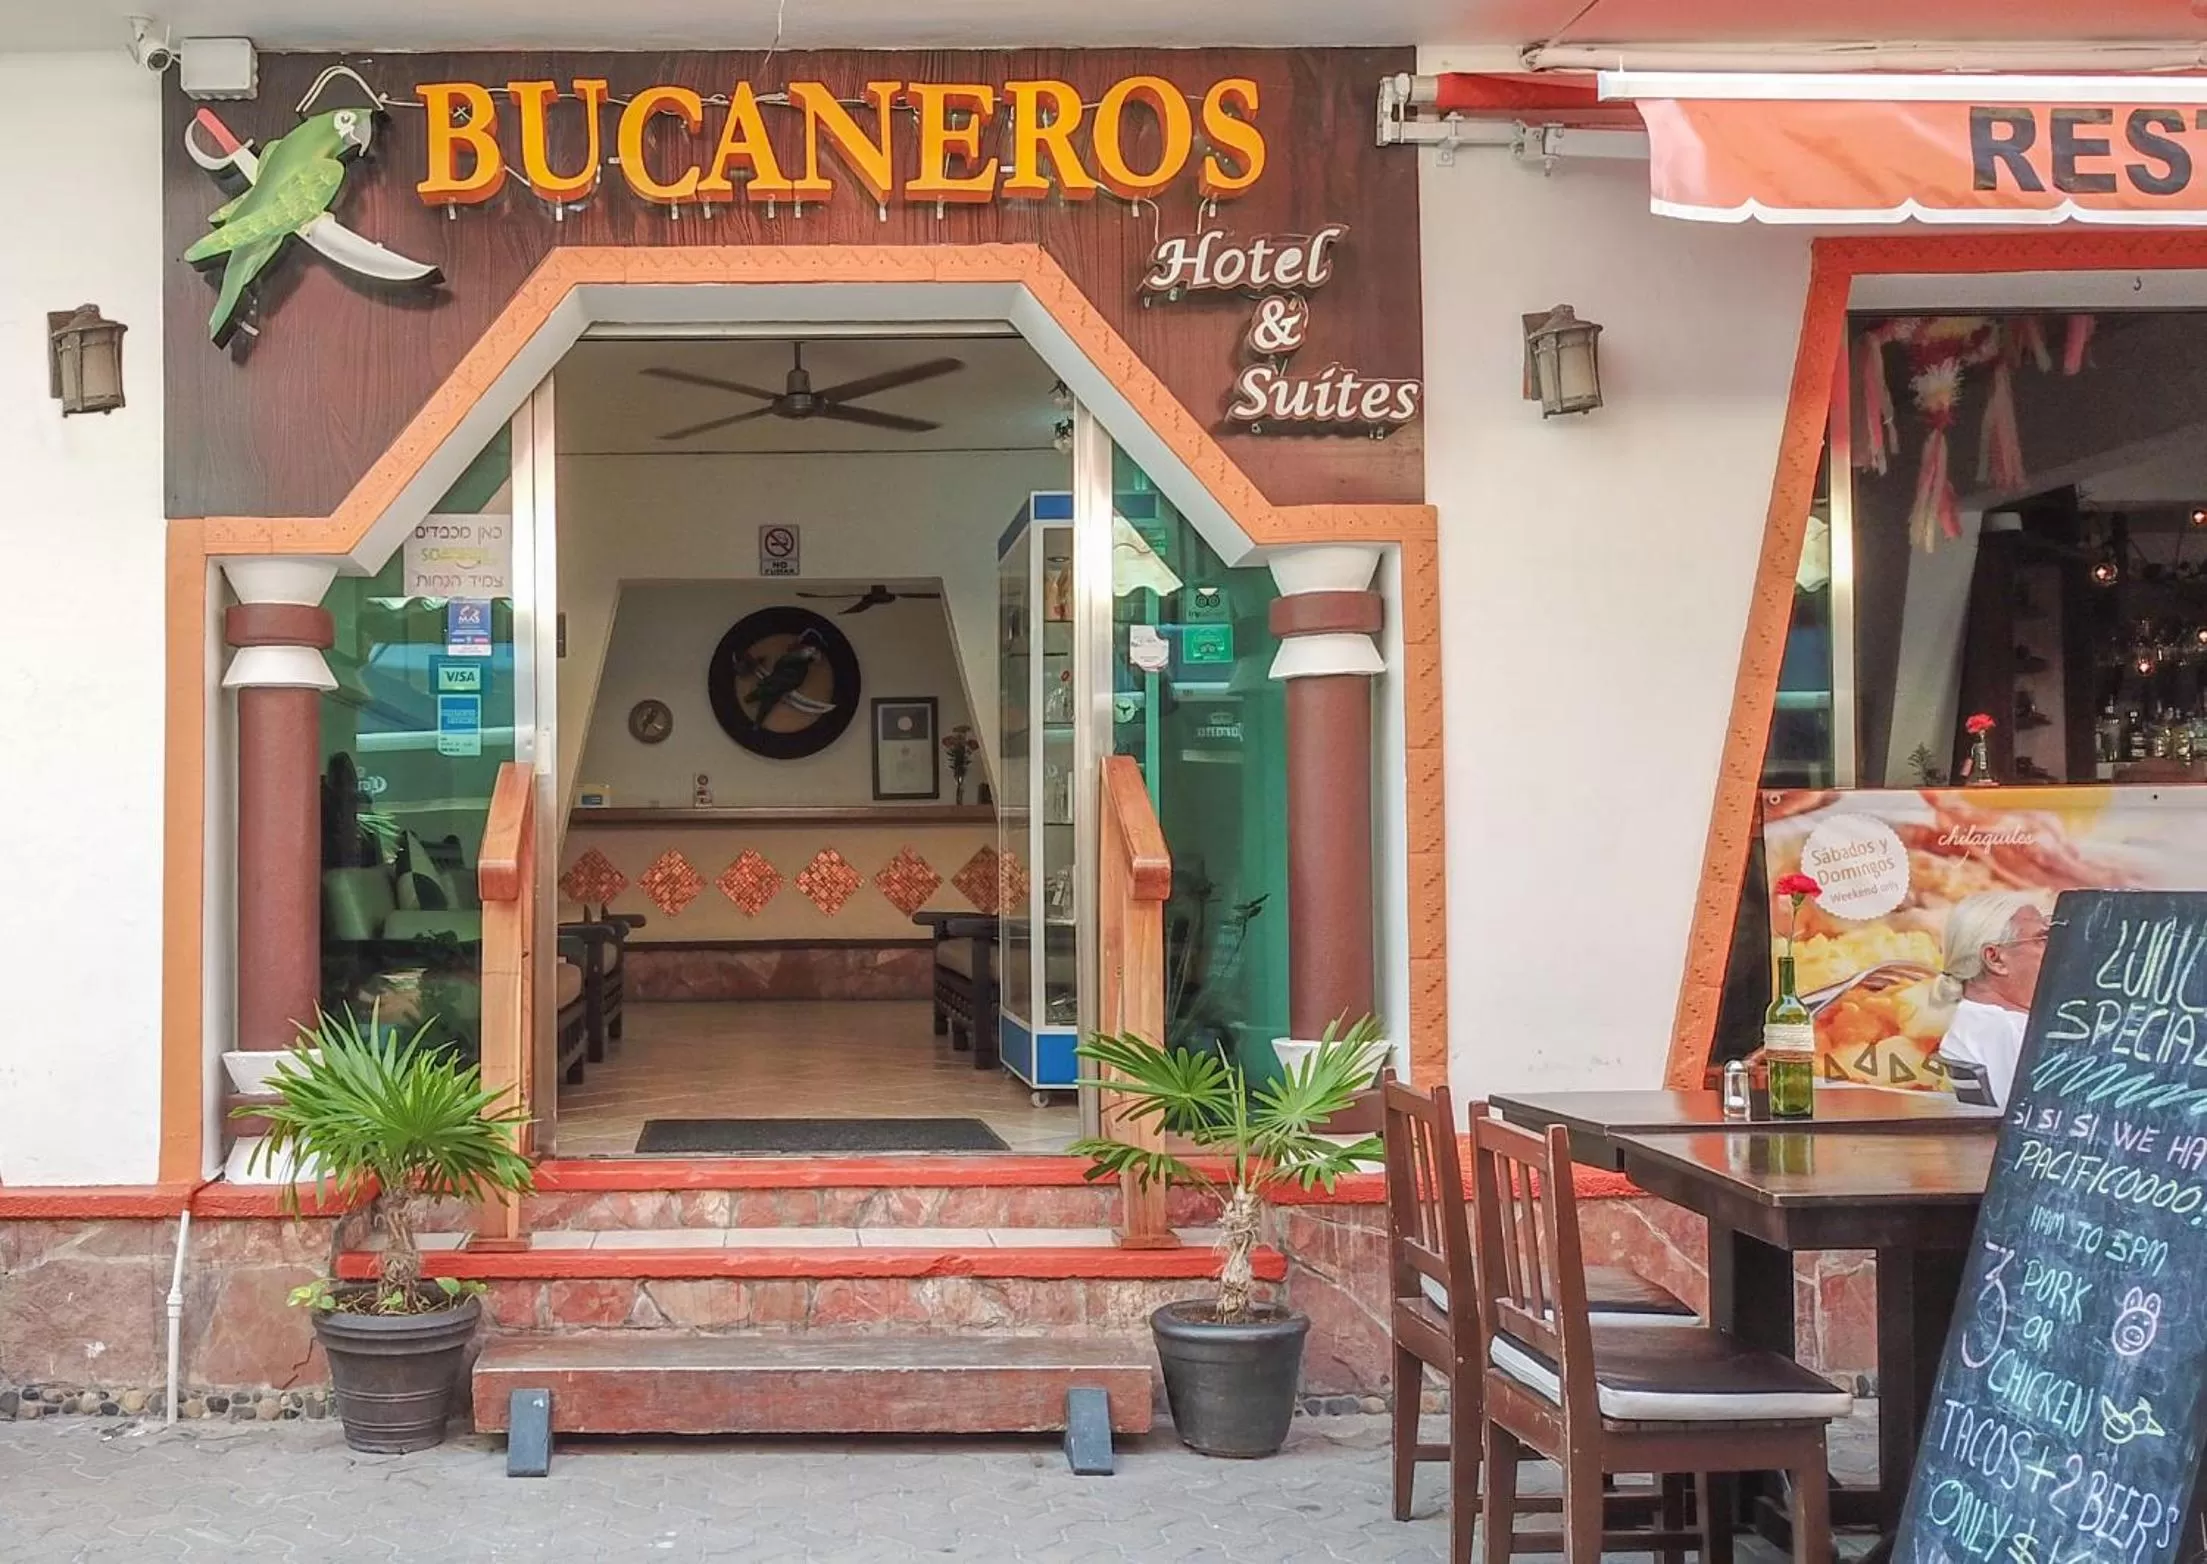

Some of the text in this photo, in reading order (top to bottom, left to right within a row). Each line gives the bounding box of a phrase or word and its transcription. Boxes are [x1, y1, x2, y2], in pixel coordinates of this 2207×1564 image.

[414, 76, 1267, 204] BUCANEROS
[1969, 105, 2207, 196] RES
[1150, 229, 1342, 286] Hotel
[1254, 300, 1302, 350] &
[414, 525, 503, 545] כאן מכבדים
[772, 561, 788, 569] NO
[446, 671, 476, 683] VISA
[1811, 838, 1889, 867] Sábados y
[1937, 824, 2036, 854] chilaquiles
[1817, 857, 1896, 886] Domingos
[1830, 884, 1878, 904] Weekend
[2096, 916, 2207, 1014] LUNC
[2038, 1108, 2063, 1130] SI
[2069, 1113, 2100, 1144] SI
[2114, 1119, 2161, 1153] WE
[2167, 1134, 2207, 1171] HA
[2076, 1220, 2104, 1254] TO
[2105, 1229, 2168, 1277] 5PM
[1961, 1241, 2016, 1369] 3
[2020, 1259, 2093, 1322] PORK
[2023, 1316, 2054, 1352] OR
[1987, 1348, 2094, 1438] CHICKEN
[1929, 1479, 2013, 1562] ONLY
[2077, 1470, 2180, 1564] BEERS
